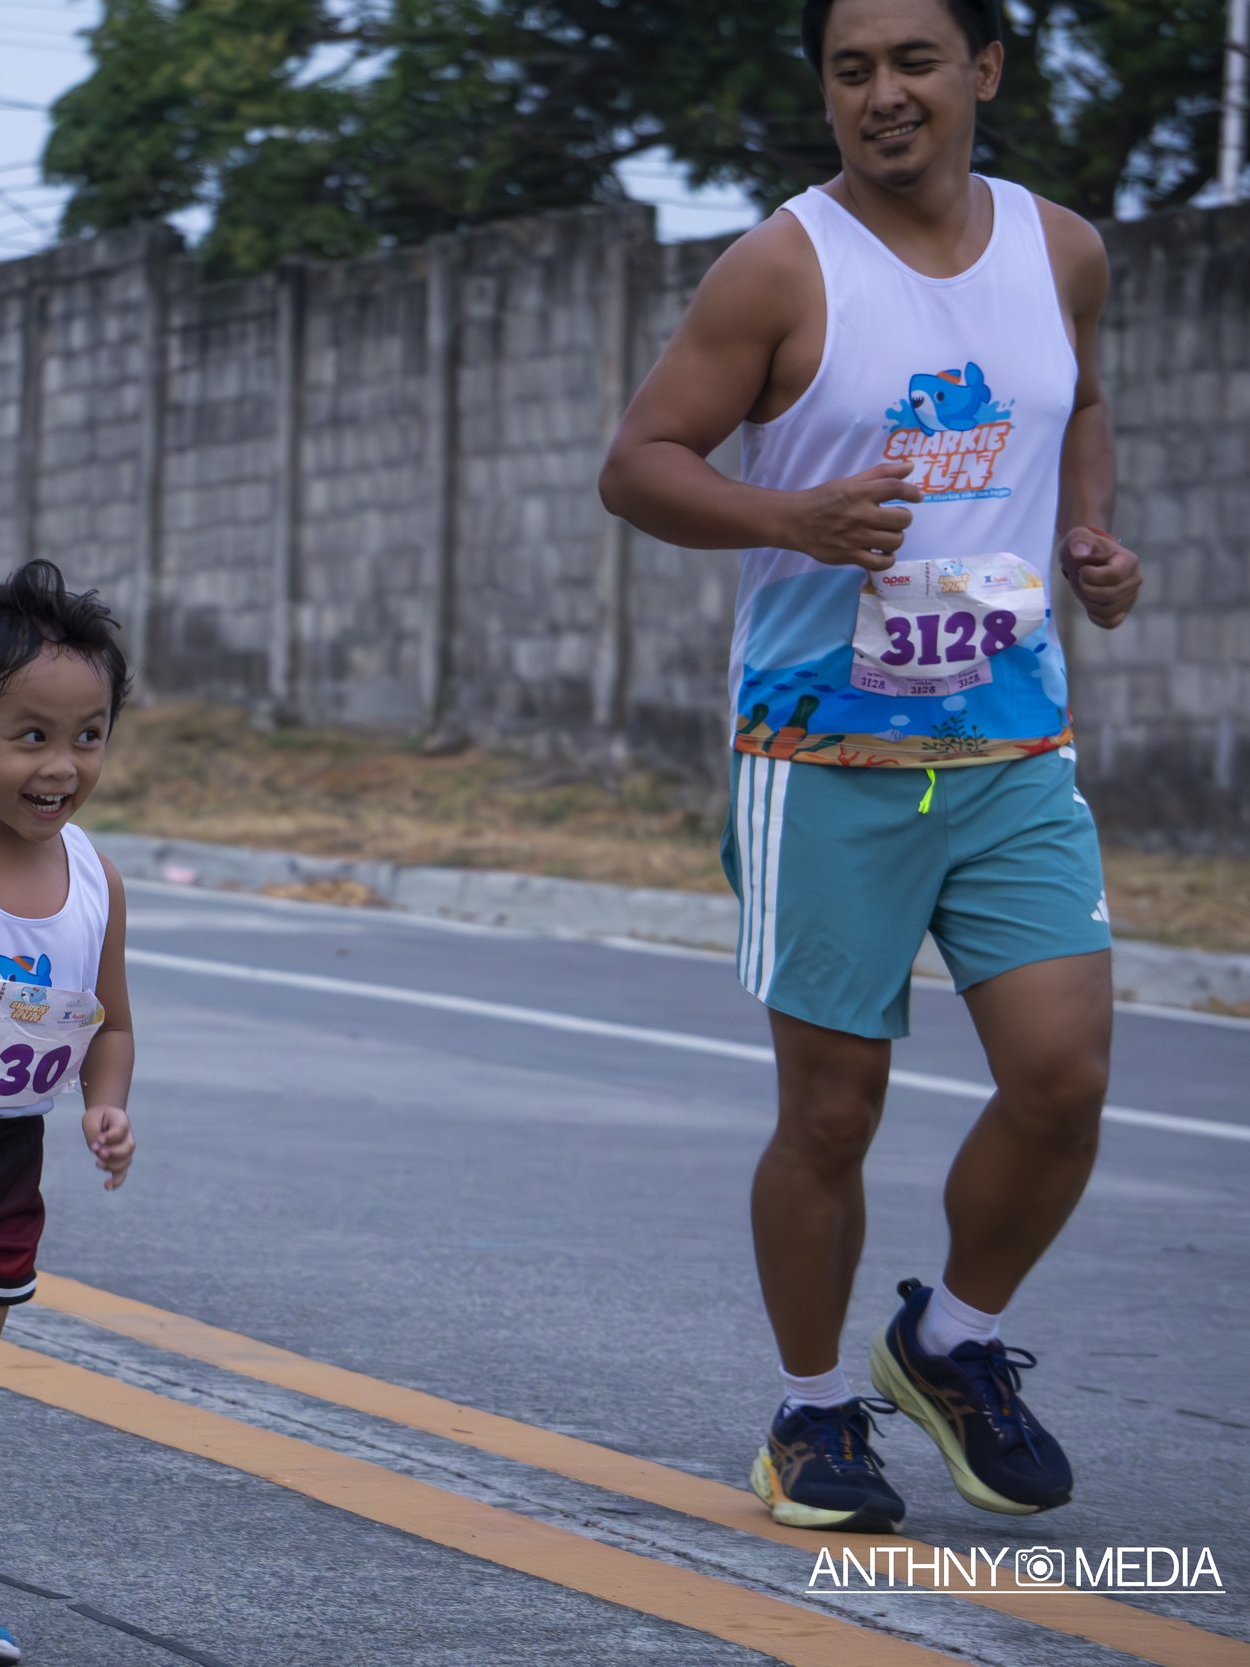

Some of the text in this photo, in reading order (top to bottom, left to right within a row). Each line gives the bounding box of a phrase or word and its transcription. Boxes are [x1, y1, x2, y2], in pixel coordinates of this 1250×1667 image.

[883, 422, 1011, 460] SHARKIE
[882, 576, 911, 587] apex
[879, 610, 1017, 666] 3128
[860, 677, 886, 690] 3128
